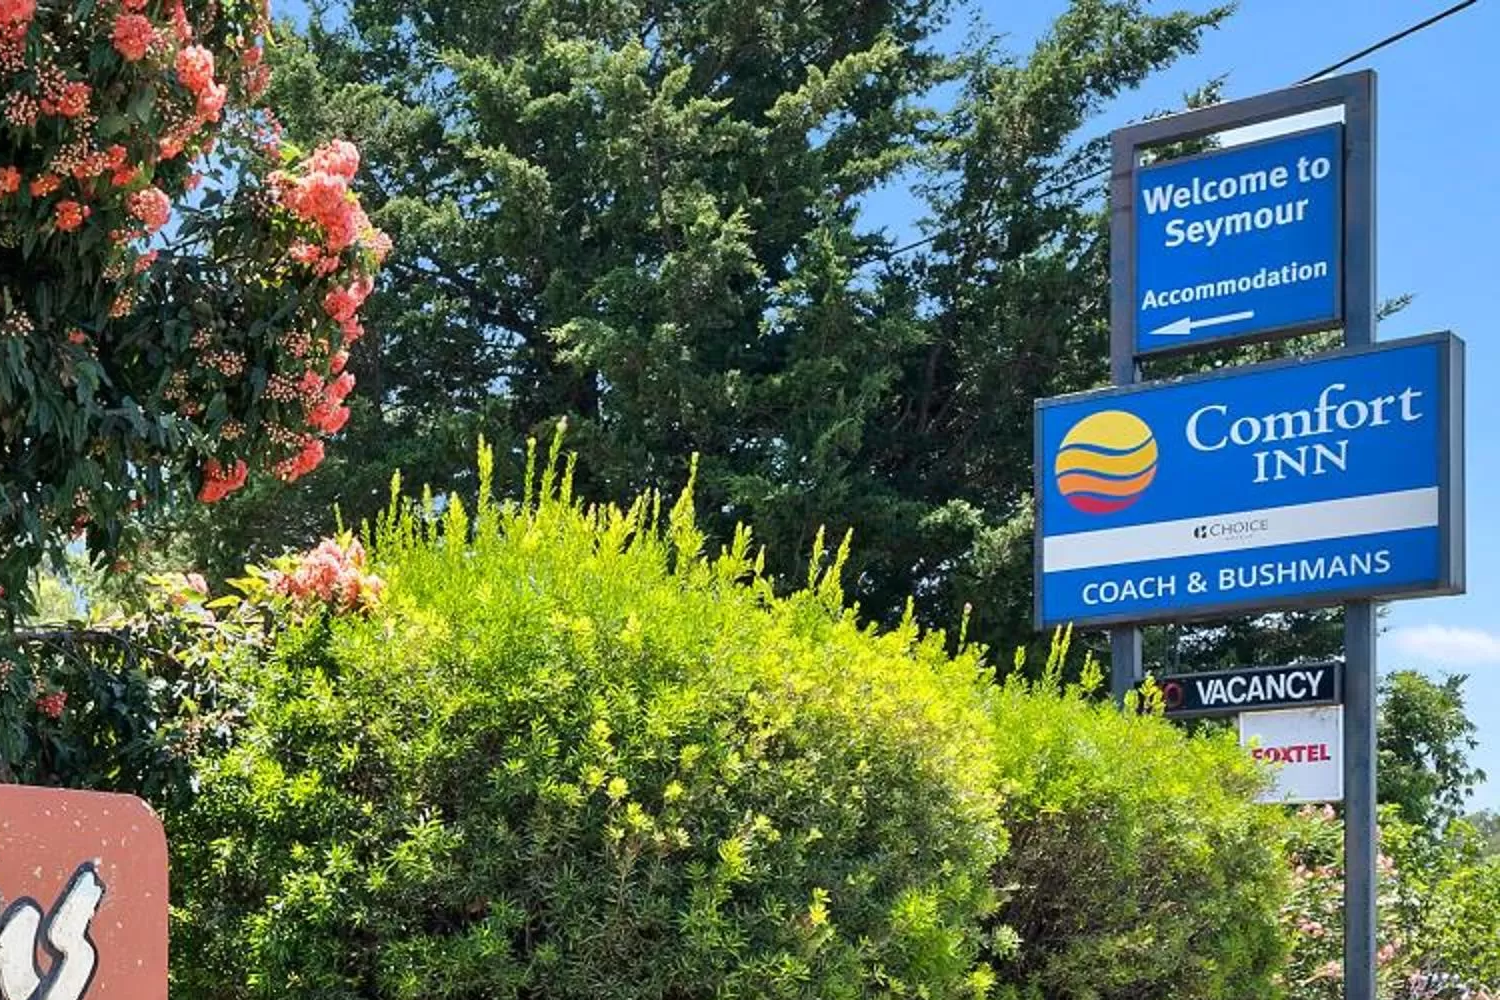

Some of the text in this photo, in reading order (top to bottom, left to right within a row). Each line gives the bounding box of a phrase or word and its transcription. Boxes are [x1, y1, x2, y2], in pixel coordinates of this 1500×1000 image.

[1143, 156, 1331, 213] Welcome to
[1164, 197, 1309, 247] Seymour
[1141, 260, 1328, 310] Accommodation
[1186, 384, 1423, 452] Comfort
[1252, 440, 1349, 483] INN
[1209, 519, 1269, 537] CHOICE
[1082, 550, 1391, 605] COACH & BUSHMANS
[1196, 670, 1324, 704] VACANCY
